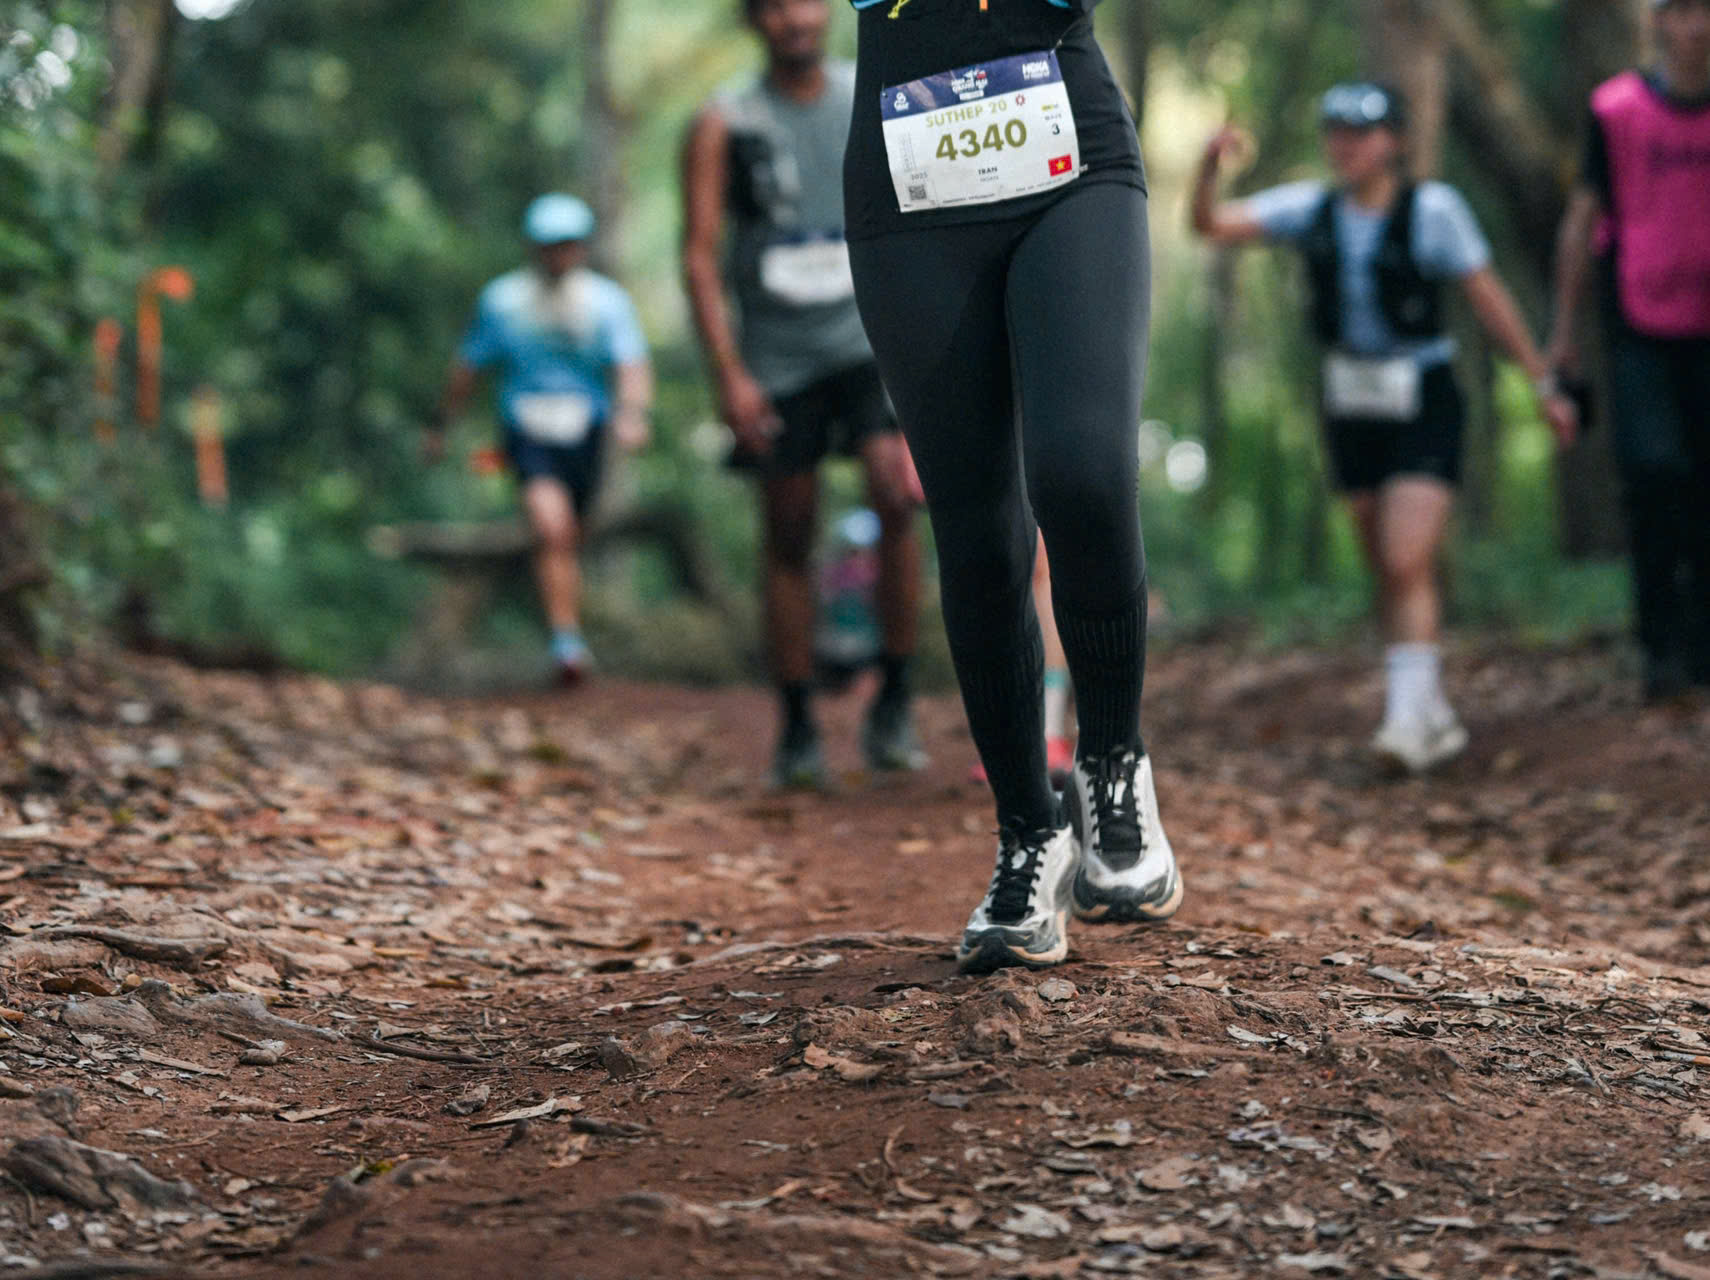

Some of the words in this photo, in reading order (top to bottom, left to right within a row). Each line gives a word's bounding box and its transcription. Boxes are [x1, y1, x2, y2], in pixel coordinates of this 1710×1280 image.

[926, 104, 983, 128] SUTHEP
[989, 99, 1007, 114] 20
[936, 118, 1027, 160] 4340
[1051, 123, 1061, 135] 3
